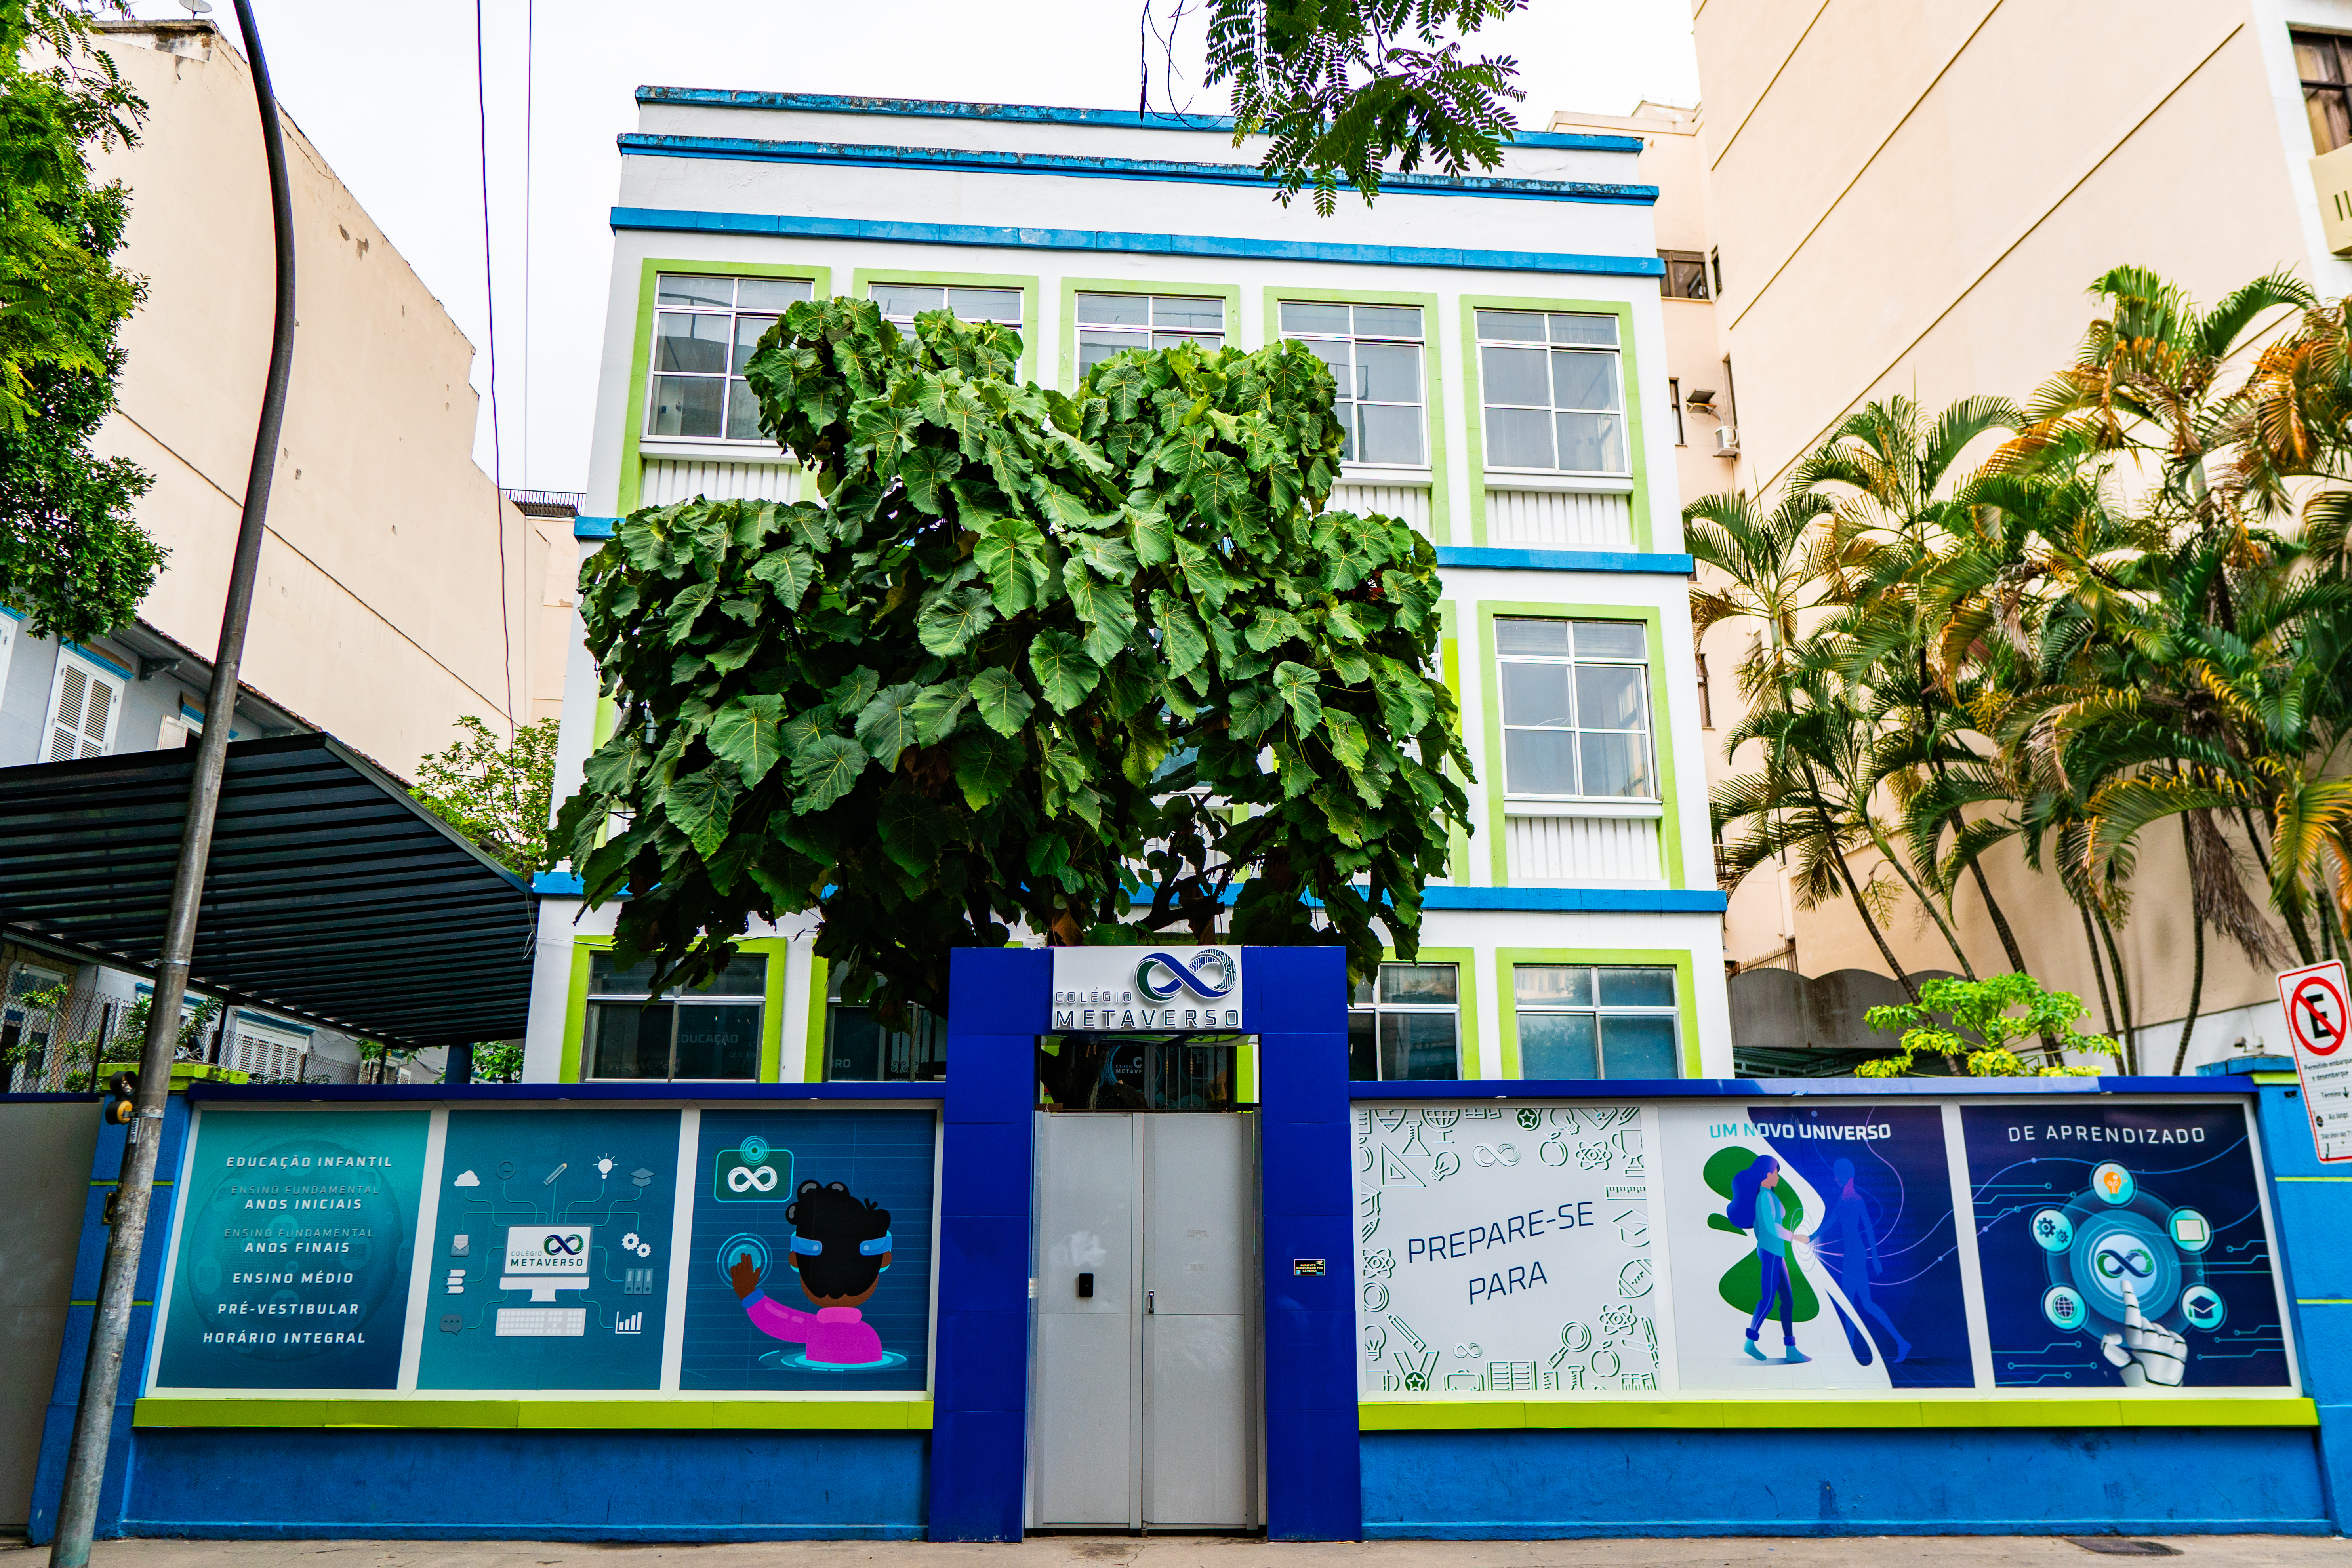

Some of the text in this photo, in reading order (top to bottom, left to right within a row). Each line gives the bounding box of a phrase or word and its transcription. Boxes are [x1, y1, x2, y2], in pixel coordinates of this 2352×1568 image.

[1055, 987, 1132, 1003] COLÉGIO
[1056, 1009, 1239, 1028] METAVERSO
[2317, 1071, 2348, 1080] desembarque
[1710, 1123, 1891, 1140] UM NOVO UNIVERSO
[2009, 1125, 2205, 1143] DE APRENDIZADO
[226, 1155, 392, 1169] EDUCAÇÃO INFANTIL
[231, 1185, 379, 1195] ENSINO FUNDAMENTAL
[244, 1199, 361, 1210] ANOS INICIAIS
[224, 1229, 374, 1238] ENSINO FUNDAMENTAL
[1409, 1202, 1594, 1263] PREPARE-SE
[244, 1242, 350, 1253] ANOS FINAIS
[233, 1270, 353, 1283] ENSINO MÉDIO
[1469, 1261, 1548, 1305] PARA
[218, 1301, 359, 1314] PRÉ-VESTIBULAR
[203, 1330, 365, 1343] HORÁRIO INTEGRAL
